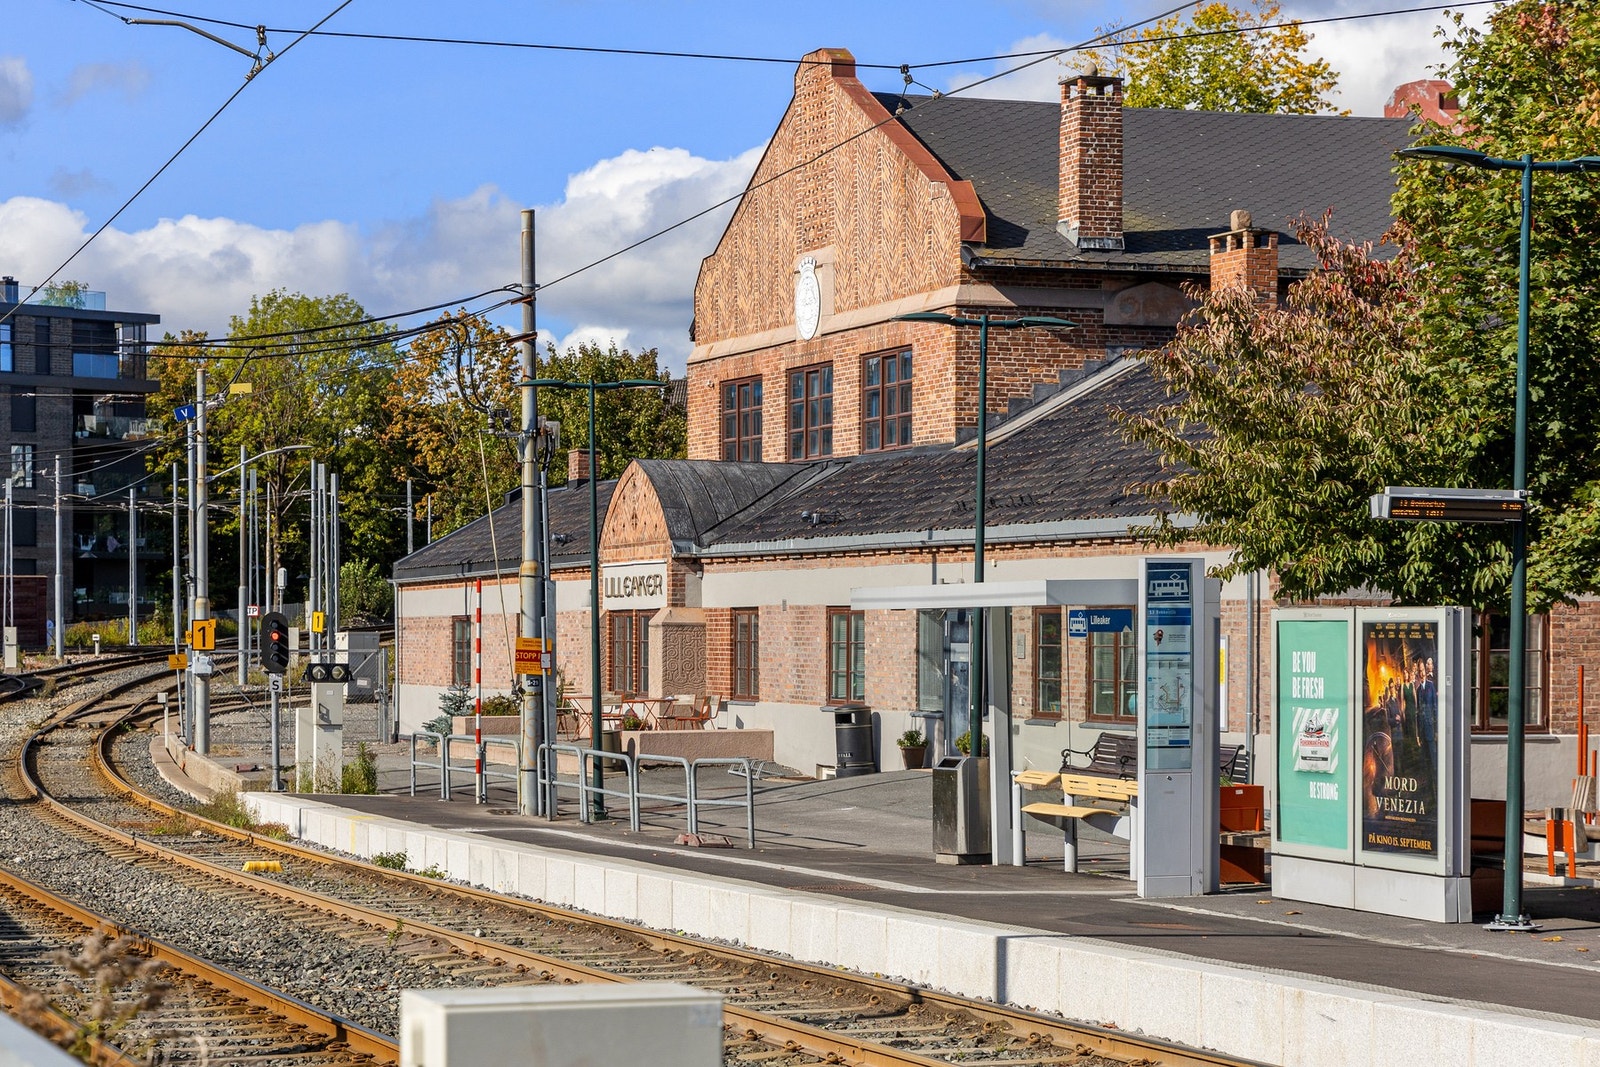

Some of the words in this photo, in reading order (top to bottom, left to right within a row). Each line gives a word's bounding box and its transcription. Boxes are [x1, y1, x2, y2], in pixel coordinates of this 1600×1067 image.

[181, 408, 188, 417] V
[605, 574, 663, 598] LILLEAKER
[316, 615, 320, 629] 1
[1090, 615, 1111, 625] Lilleaker
[197, 625, 206, 648] 1
[516, 651, 537, 660] STOPP
[1292, 651, 1301, 673] BE
[1301, 651, 1317, 674] YOU
[272, 680, 279, 690] S
[1292, 676, 1301, 699] BE
[1301, 676, 1325, 699] FRESH
[1309, 781, 1316, 799] BE
[1316, 782, 1339, 802] STRONG
[1384, 776, 1418, 792] MORD
[1376, 796, 1425, 815] VENEZIA
[1368, 832, 1376, 844] PÅ
[1376, 834, 1392, 846] KINO
[1399, 837, 1432, 850] SEPTEMBER
